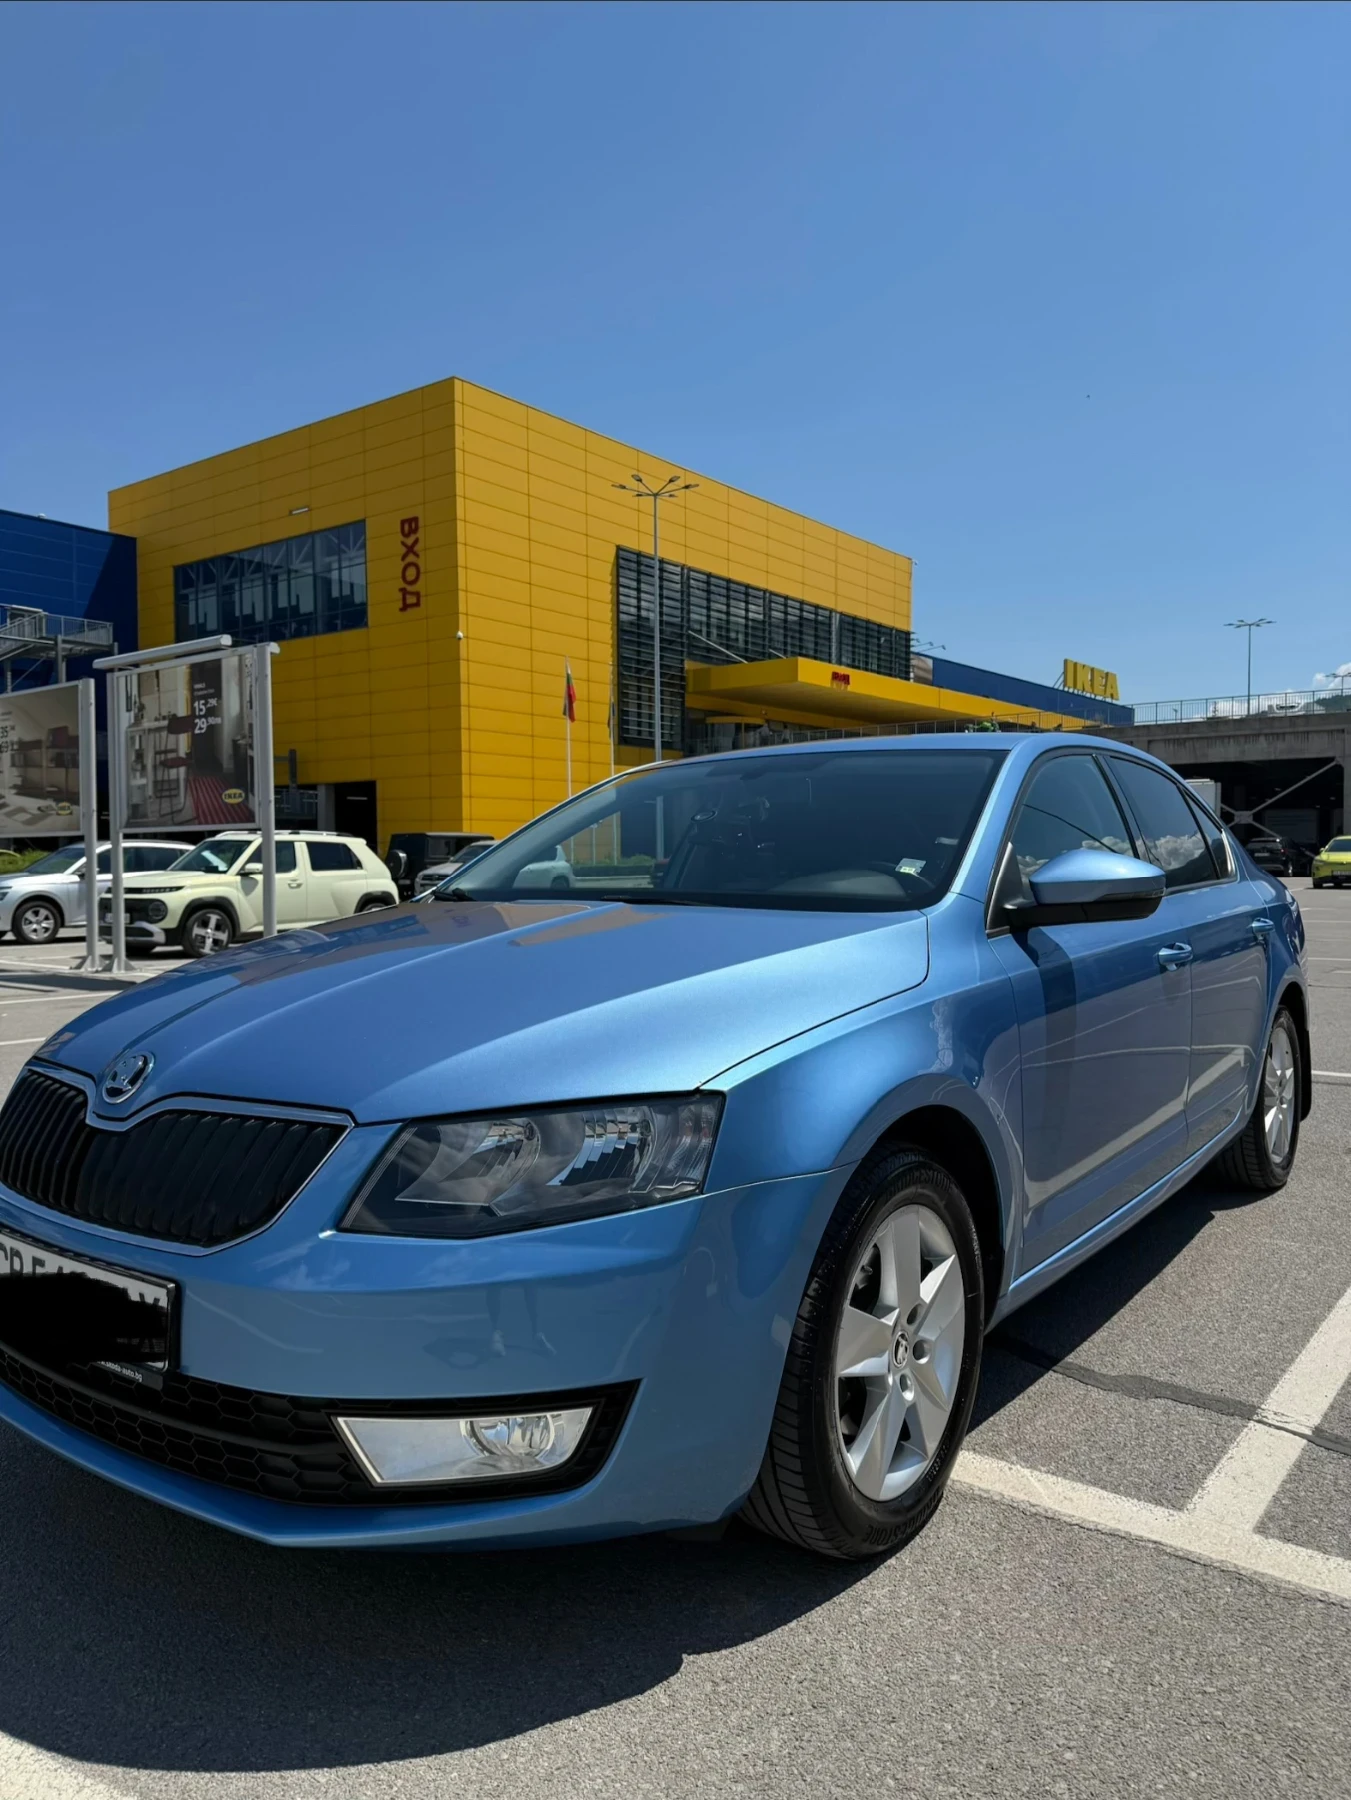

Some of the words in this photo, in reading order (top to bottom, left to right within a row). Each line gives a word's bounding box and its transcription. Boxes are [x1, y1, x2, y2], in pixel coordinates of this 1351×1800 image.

[399, 516, 421, 612] ВХОД
[1064, 659, 1119, 700] IKEA
[224, 792, 244, 800] IKEA
